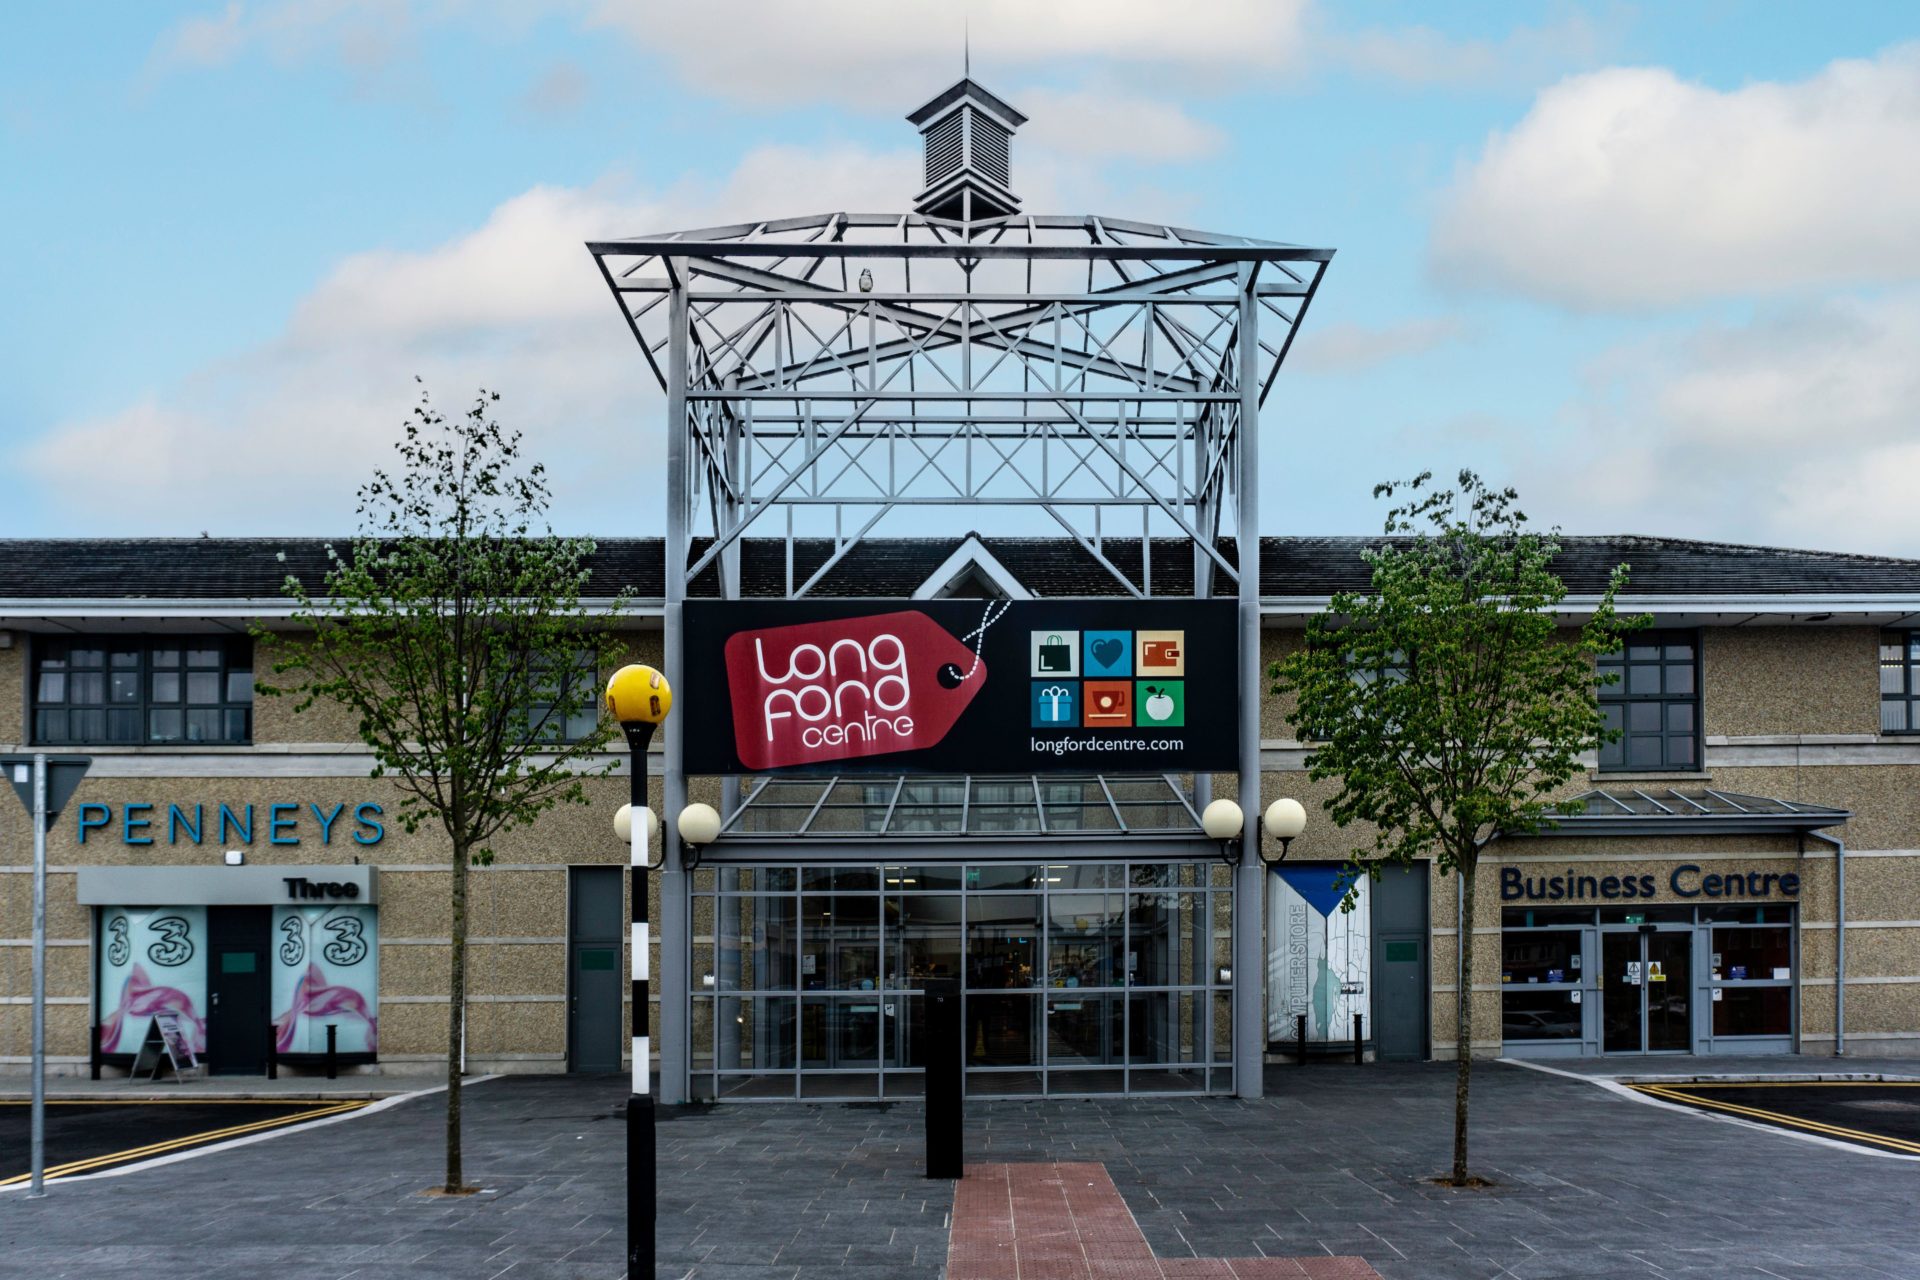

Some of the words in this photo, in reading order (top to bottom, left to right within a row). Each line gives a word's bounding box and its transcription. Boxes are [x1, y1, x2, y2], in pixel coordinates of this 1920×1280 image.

[755, 633, 909, 684] Long
[764, 675, 911, 742] ford
[802, 710, 914, 748] centre
[1031, 735, 1185, 756] longfordcentre.com
[78, 802, 385, 845] PENNEYS
[283, 877, 359, 899] Three
[1500, 866, 1656, 901] Business
[1669, 864, 1801, 899] Centre
[1289, 904, 1308, 955] STORE
